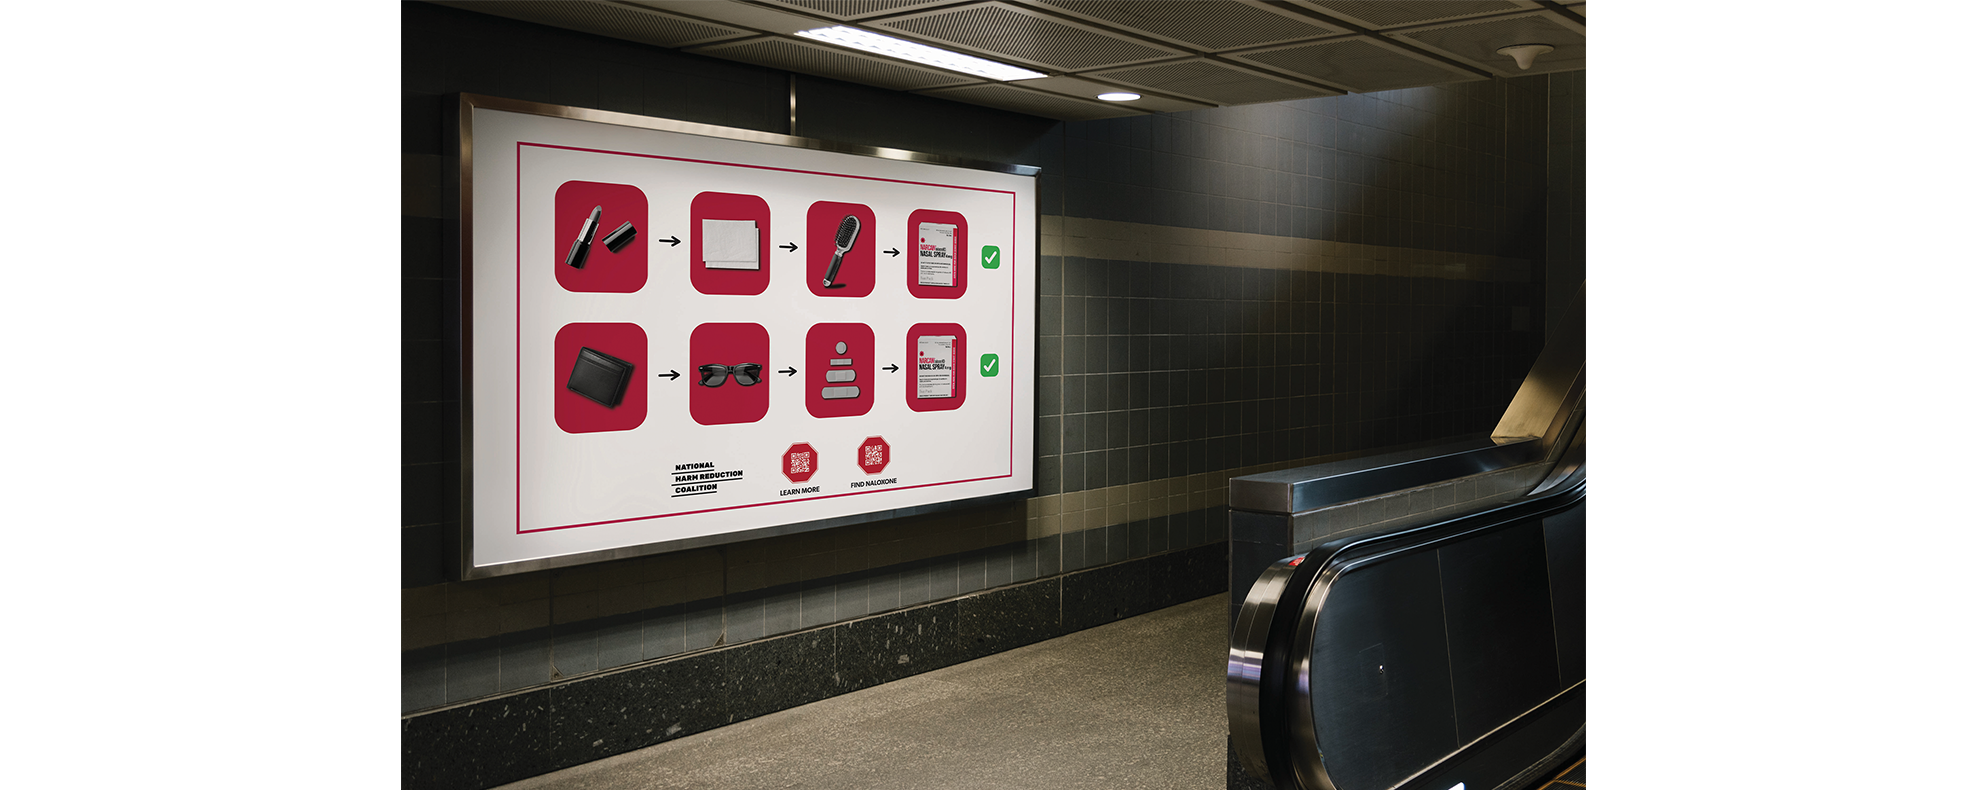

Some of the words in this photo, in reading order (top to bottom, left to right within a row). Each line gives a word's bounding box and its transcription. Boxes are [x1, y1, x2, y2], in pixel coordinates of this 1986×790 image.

[675, 462, 714, 471] NATIONAL
[675, 474, 698, 482] HARM
[699, 470, 743, 480] REDUCTION
[865, 478, 897, 487] NALOXONE
[675, 483, 717, 493] COALITION
[779, 488, 801, 496] LEARN
[801, 486, 820, 494] MORE
